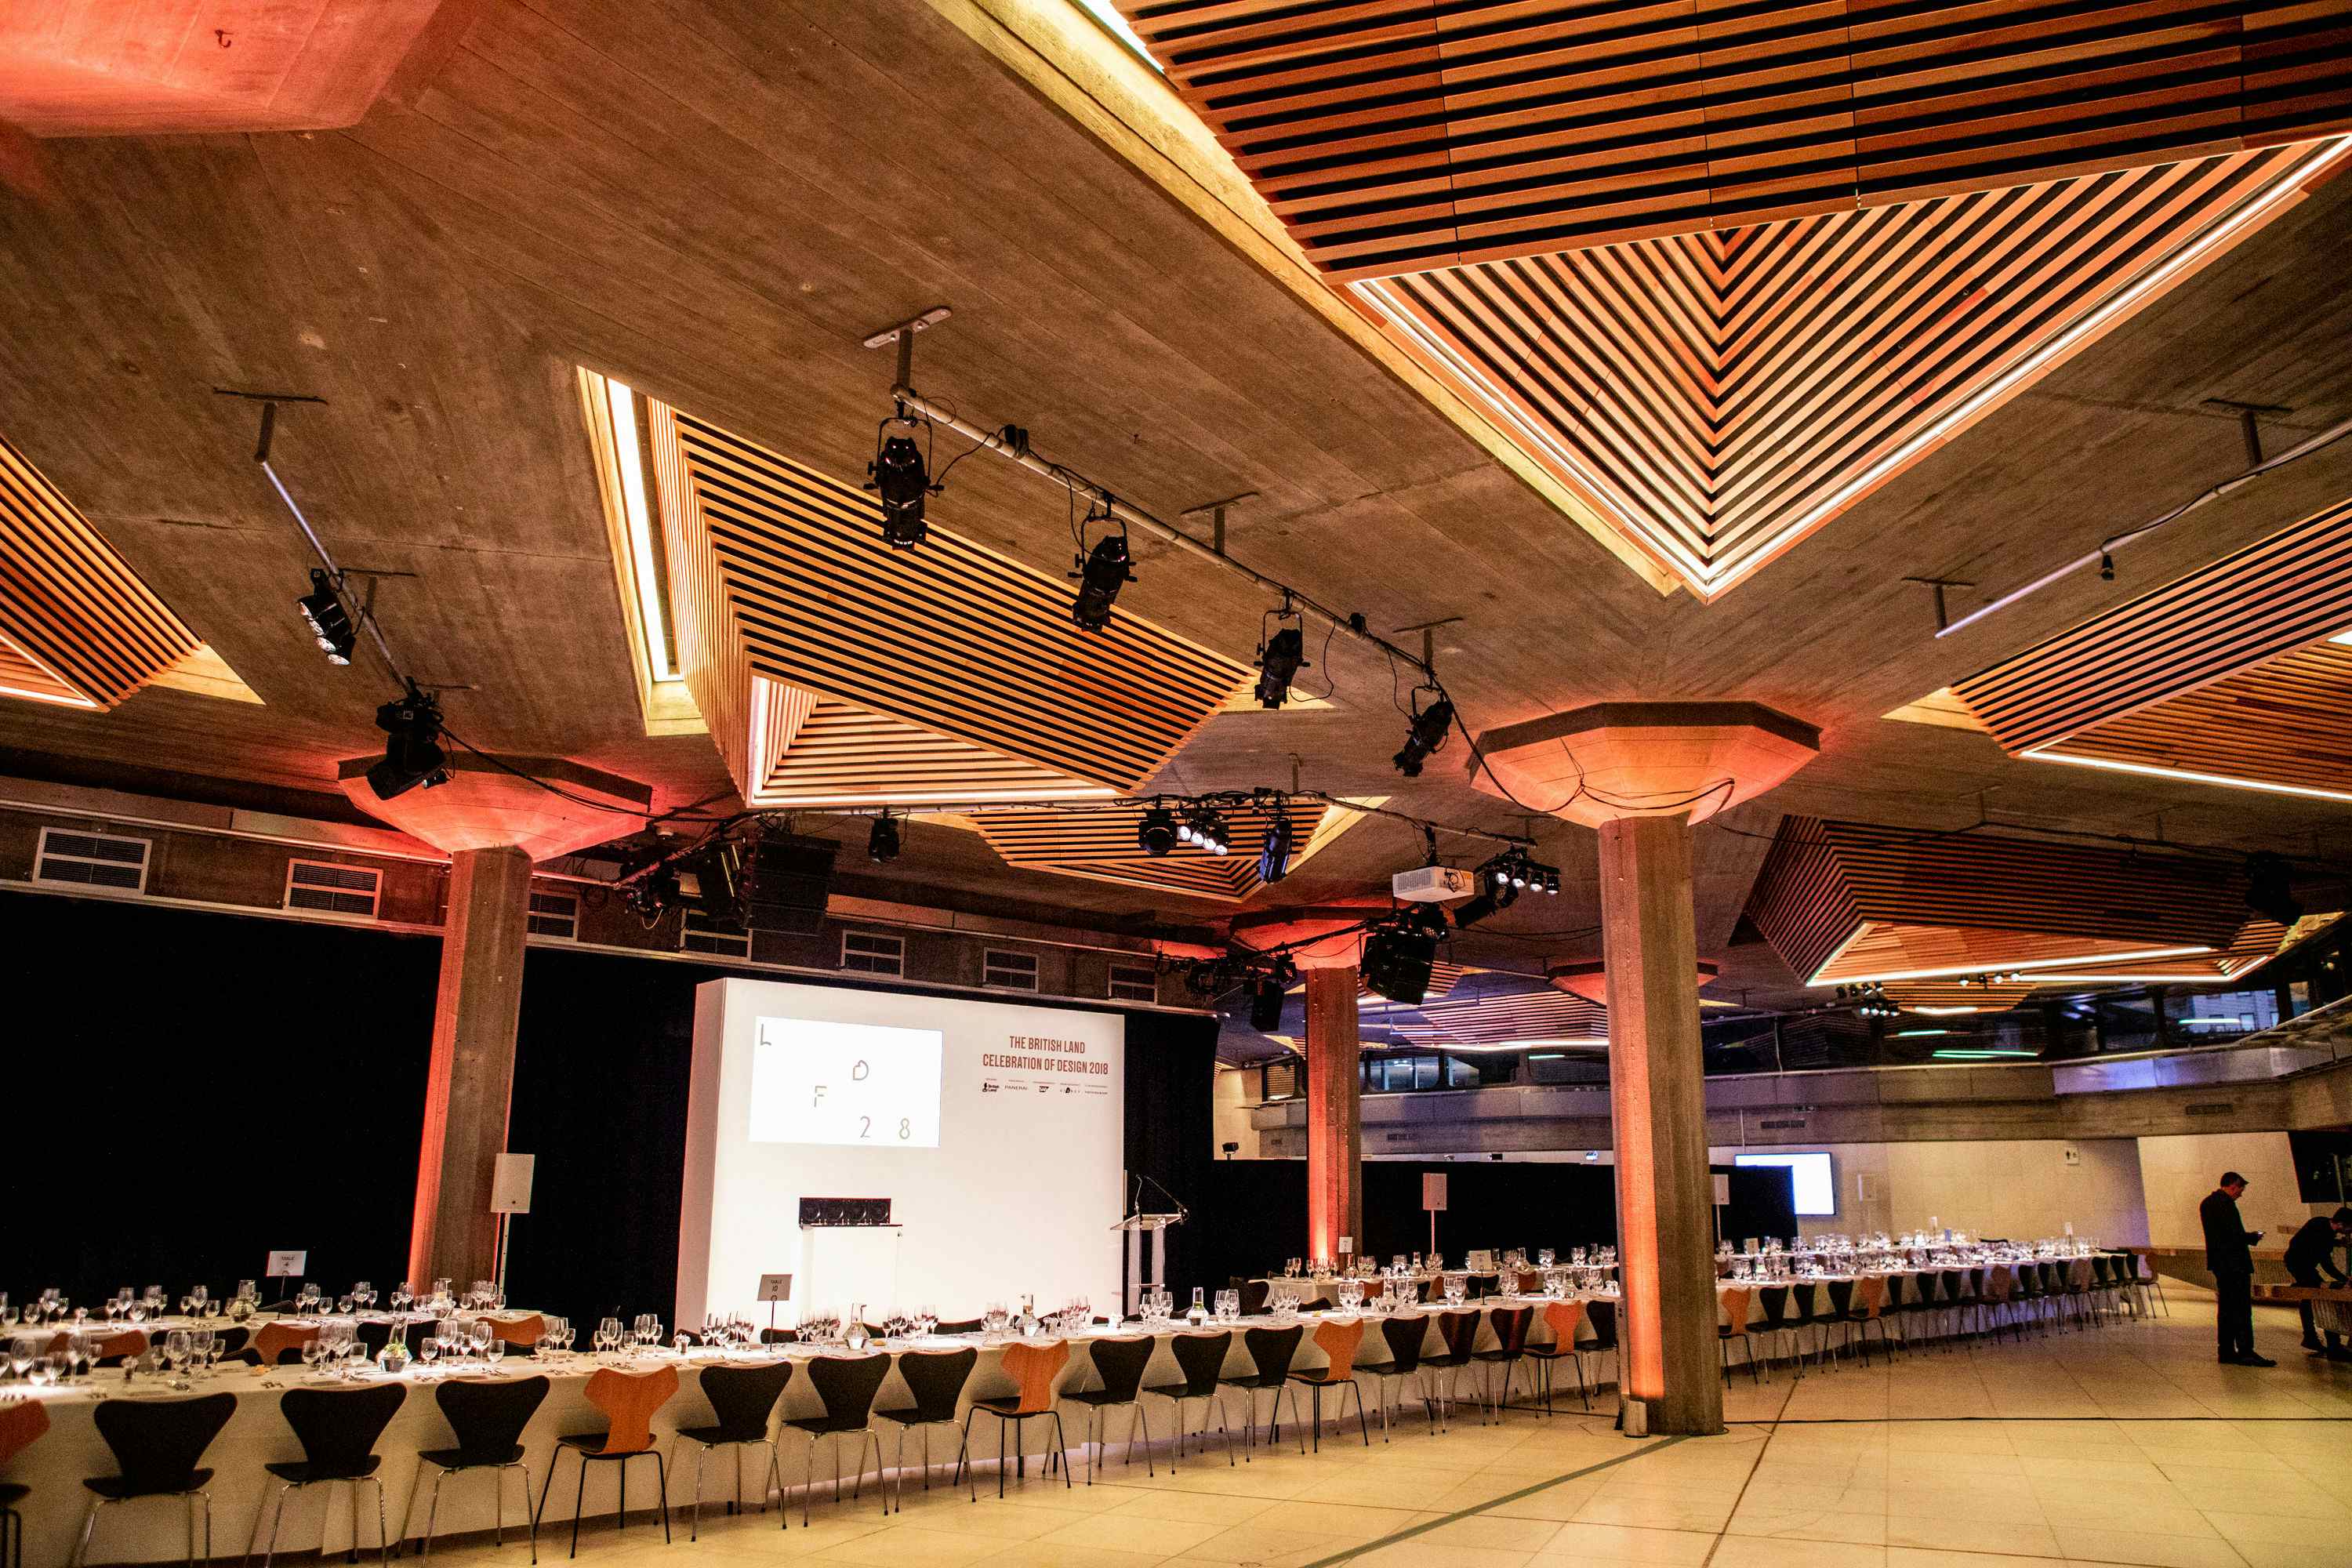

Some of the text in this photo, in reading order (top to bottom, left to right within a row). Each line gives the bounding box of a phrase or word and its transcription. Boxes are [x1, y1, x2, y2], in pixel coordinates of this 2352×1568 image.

[760, 1023, 771, 1046] L
[1010, 1036, 1086, 1054] THE BRITISH LAND
[982, 1054, 1109, 1075] CELEBRATION OF DESIGN 2018
[814, 1085, 827, 1107] F
[859, 1116, 910, 1139] 2 8
